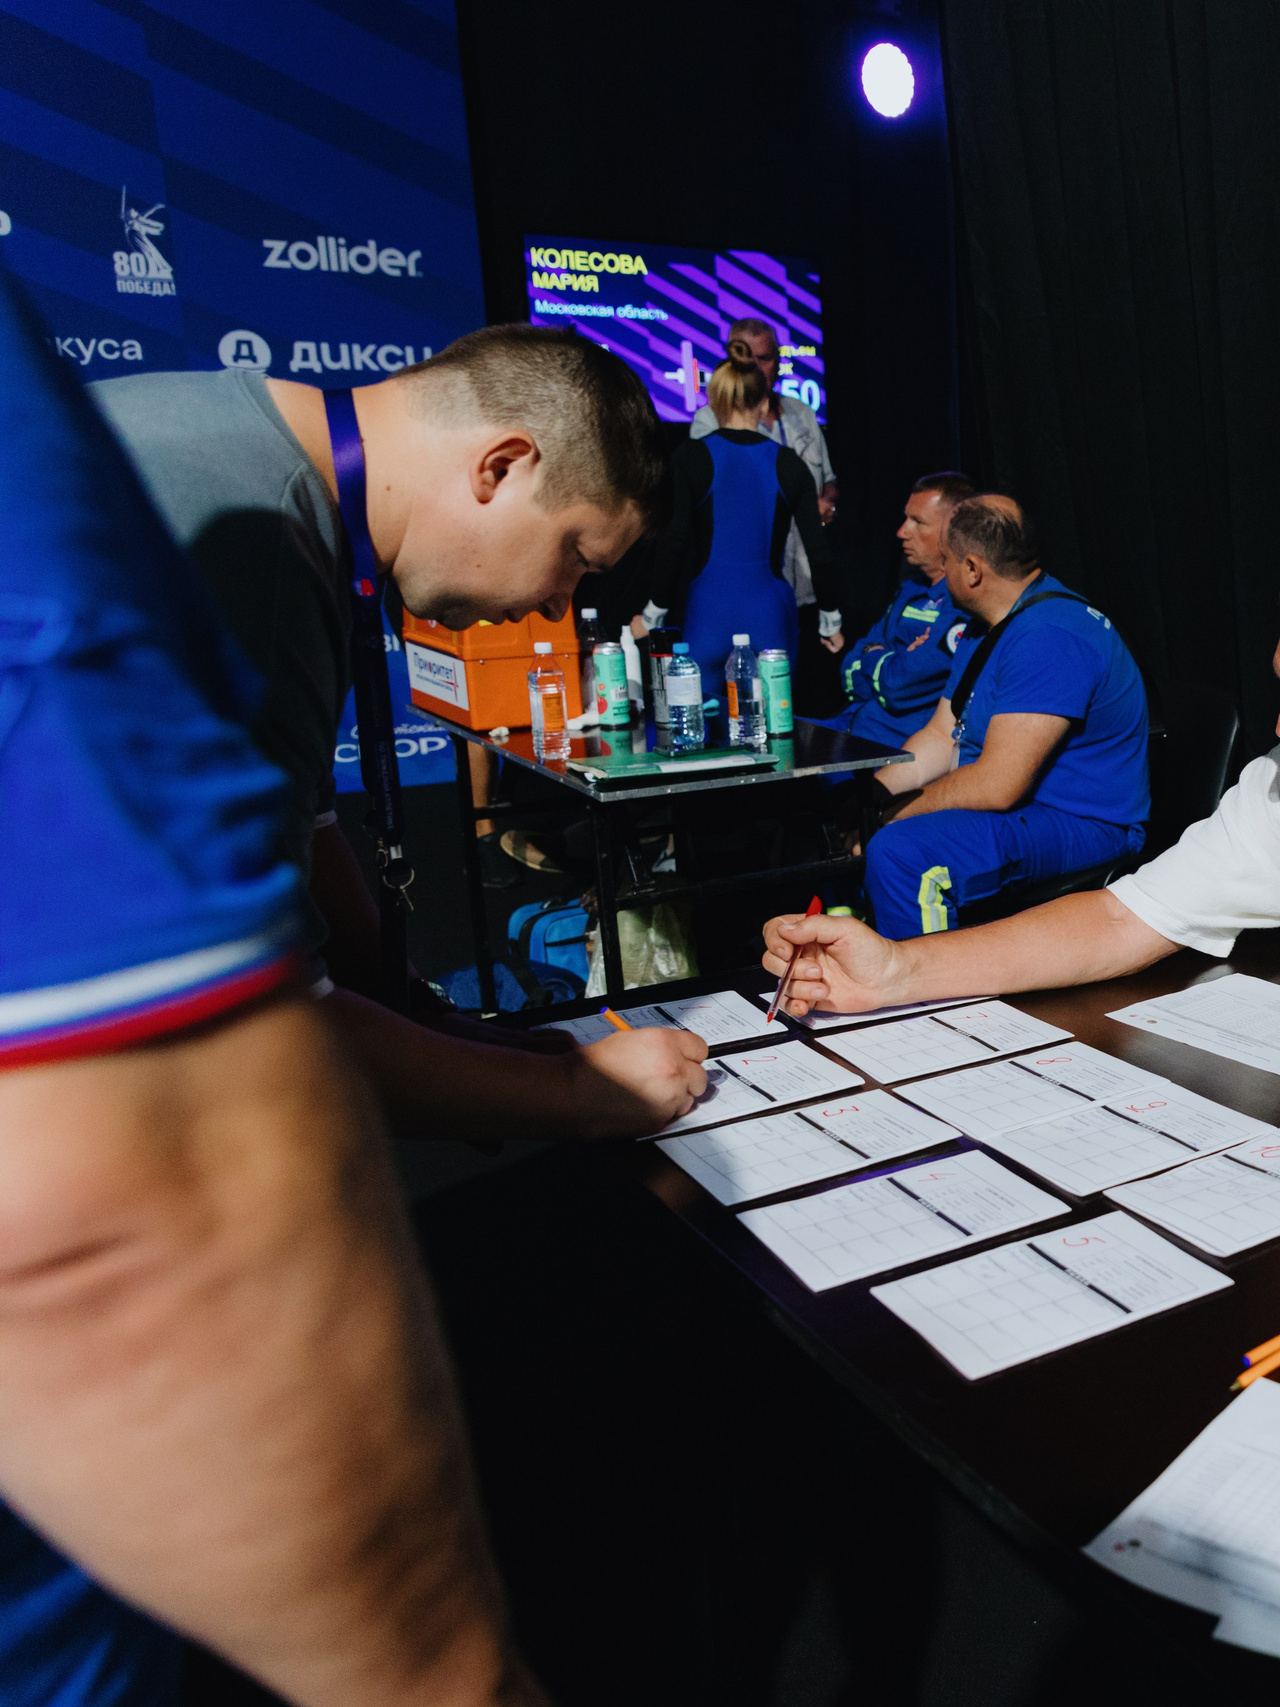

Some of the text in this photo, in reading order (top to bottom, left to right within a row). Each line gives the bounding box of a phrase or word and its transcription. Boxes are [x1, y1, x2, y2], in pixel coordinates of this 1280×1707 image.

[262, 234, 423, 278] zollider
[530, 246, 648, 276] КОЛЕСОВА
[116, 279, 176, 297] ПОБЕДА!
[532, 271, 599, 293] МАРИЯ
[534, 299, 669, 320] Московская область
[54, 336, 144, 366] куса
